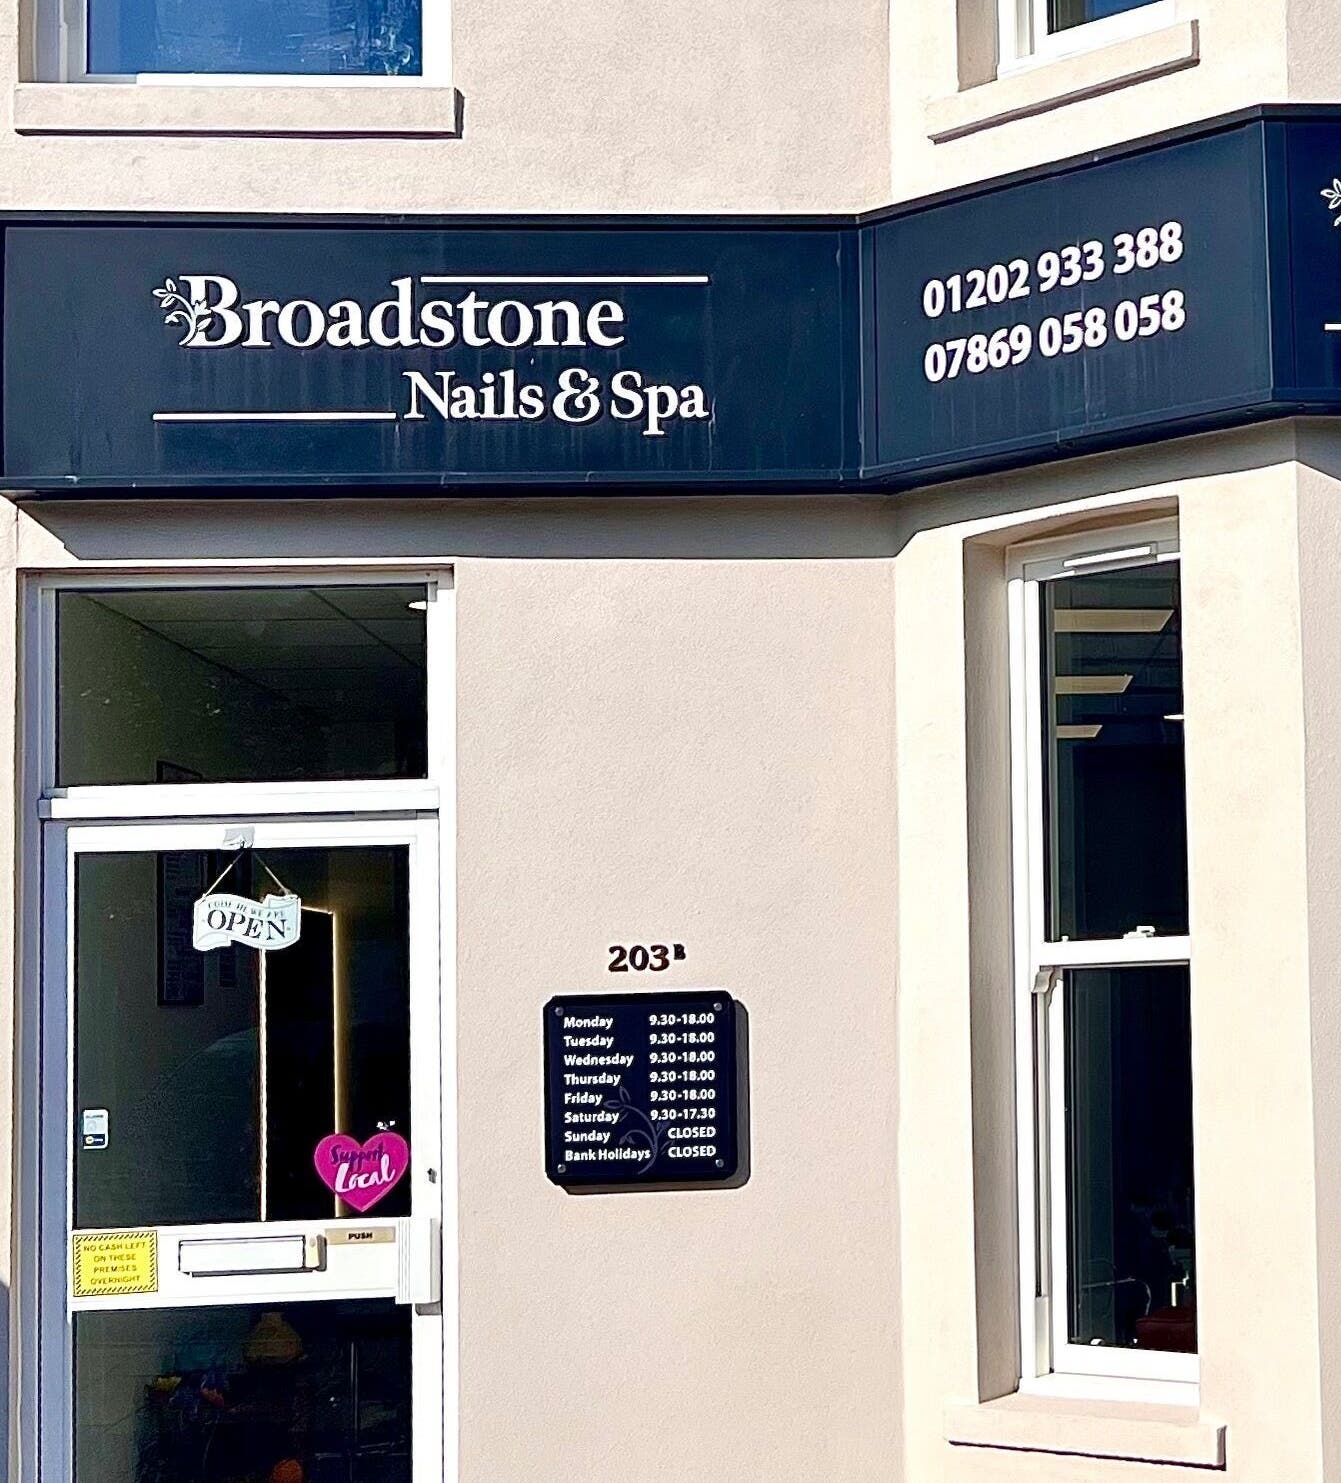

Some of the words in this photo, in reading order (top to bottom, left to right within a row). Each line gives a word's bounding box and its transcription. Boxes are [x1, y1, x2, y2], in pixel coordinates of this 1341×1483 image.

[924, 260, 1030, 317] 01202
[1038, 241, 1104, 291] 933
[1114, 222, 1182, 273] 388
[172, 275, 625, 348] Broadstone
[925, 325, 1031, 381] 07869
[1040, 308, 1107, 356] 058
[1115, 290, 1185, 340] 058
[403, 369, 544, 419] Nails
[553, 369, 600, 422] &
[611, 371, 709, 435] Spa
[207, 909, 286, 940] OPEN
[564, 1016, 613, 1030] Monday
[649, 1013, 714, 1025] 9.30-18.00
[564, 1035, 614, 1048] Tuesday
[650, 1032, 714, 1044] 9.30-18.00
[564, 1053, 634, 1067] Wednesday
[650, 1051, 715, 1063] 9.30-18.00
[564, 1072, 620, 1086] Thursday
[650, 1070, 715, 1082] 9.30-18.00
[565, 1092, 602, 1106] Friday
[651, 1089, 715, 1101] 9.30-18.00
[565, 1111, 619, 1124] Saturday
[651, 1108, 715, 1120] 9.30-17.30
[565, 1130, 610, 1143] Sunday
[668, 1127, 716, 1138] CLOSED
[331, 1142, 384, 1171] Support
[566, 1149, 596, 1161] Bank
[598, 1148, 650, 1161] Holidays
[668, 1146, 716, 1157] CLOSED
[335, 1153, 396, 1193] Local
[98, 1244, 123, 1252] CASH
[125, 1241, 146, 1250] LEFT
[93, 1255, 107, 1263] ON
[109, 1253, 137, 1261] THESE
[93, 1265, 137, 1273] PREMISES
[90, 1275, 141, 1285] OVERNIGHT
